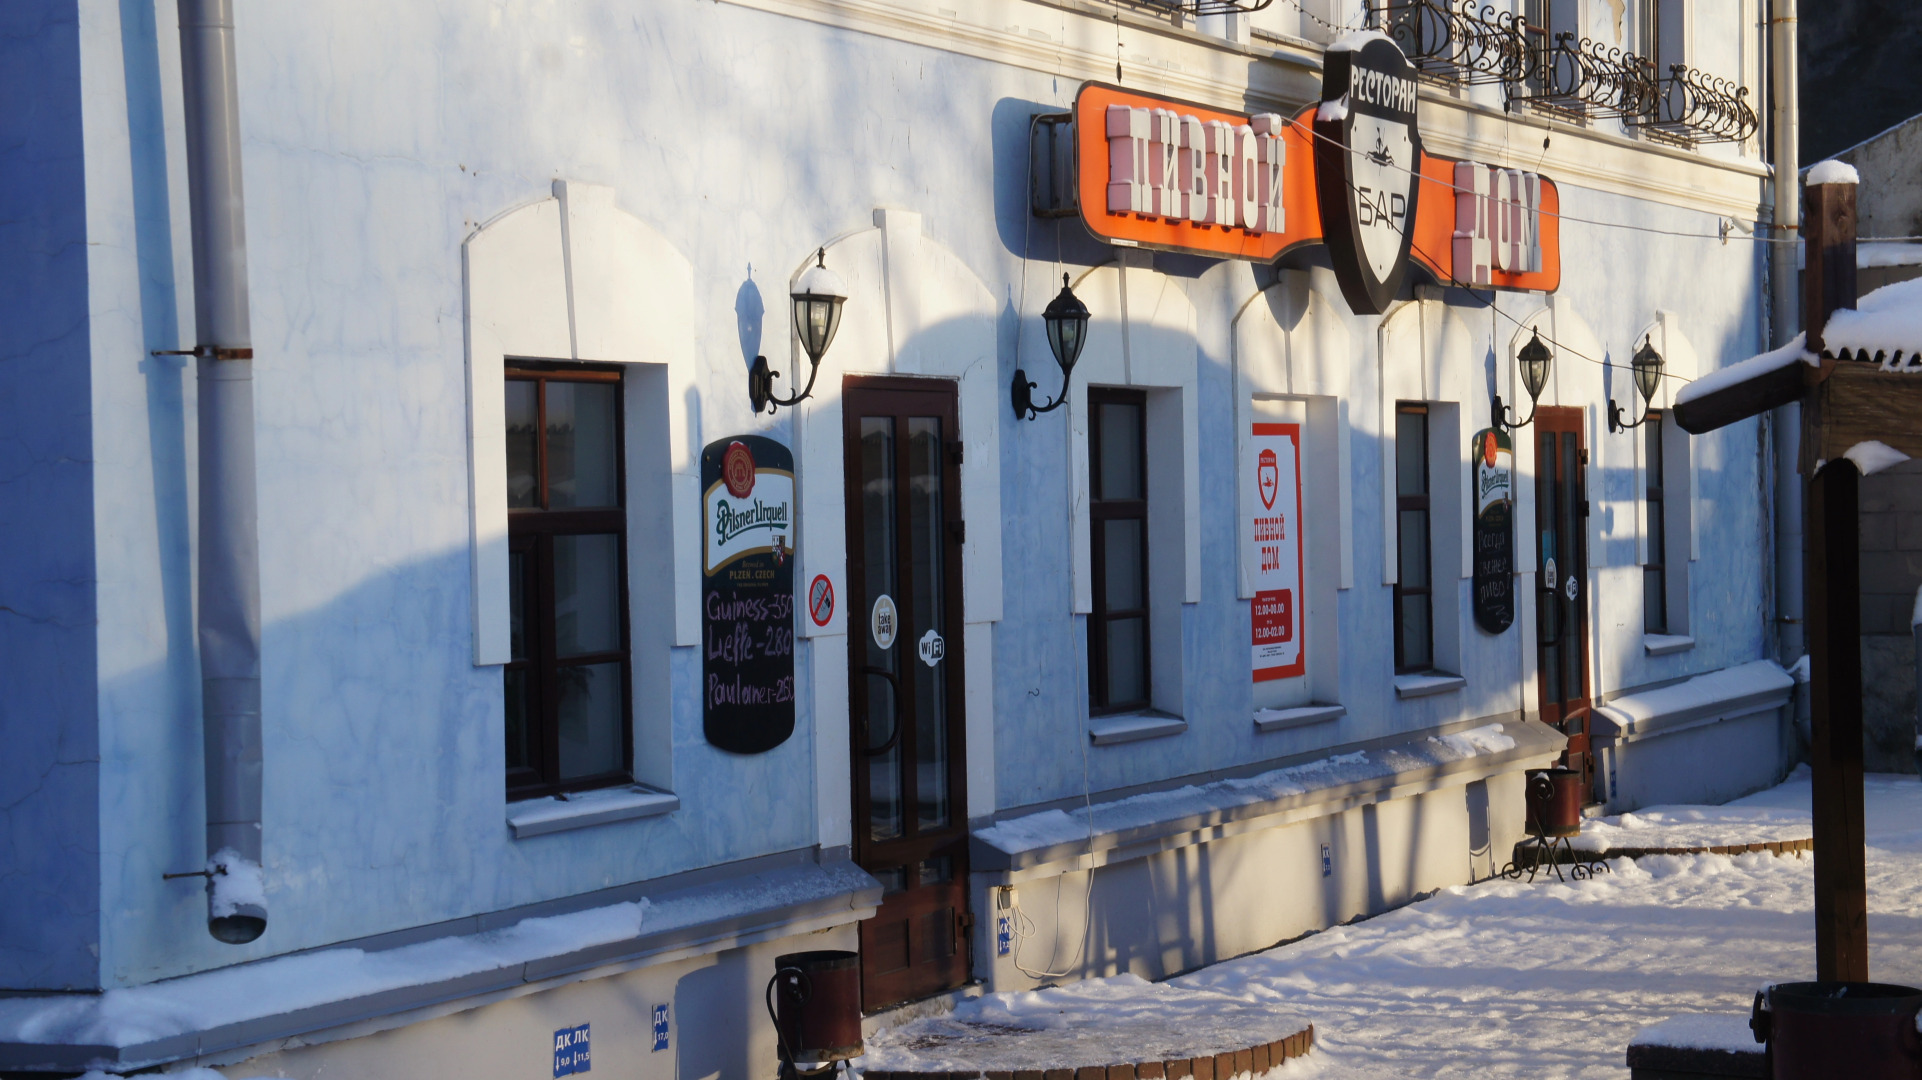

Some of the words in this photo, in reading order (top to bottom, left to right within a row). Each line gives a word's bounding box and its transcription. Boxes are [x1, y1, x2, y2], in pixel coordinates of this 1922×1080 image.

[1351, 64, 1417, 114] РЕСТОРАН
[1108, 106, 1286, 234] ПИВНОЙ
[1454, 161, 1542, 285] ДОМ
[1359, 186, 1406, 230] БАР
[716, 499, 756, 546] Pilsner
[753, 497, 788, 532] Urquell
[1254, 513, 1285, 542] ПИВНОЙ
[1261, 546, 1280, 575] ДОМ
[755, 569, 775, 580] CZECH
[877, 624, 892, 636] away
[878, 613, 891, 625] take
[654, 1010, 668, 1026] ДК
[555, 1033, 571, 1051] ДК
[573, 1029, 589, 1044] ЛК
[657, 1031, 669, 1041] 17,0
[560, 1056, 570, 1067] 9,0
[577, 1051, 590, 1062] 11,5
